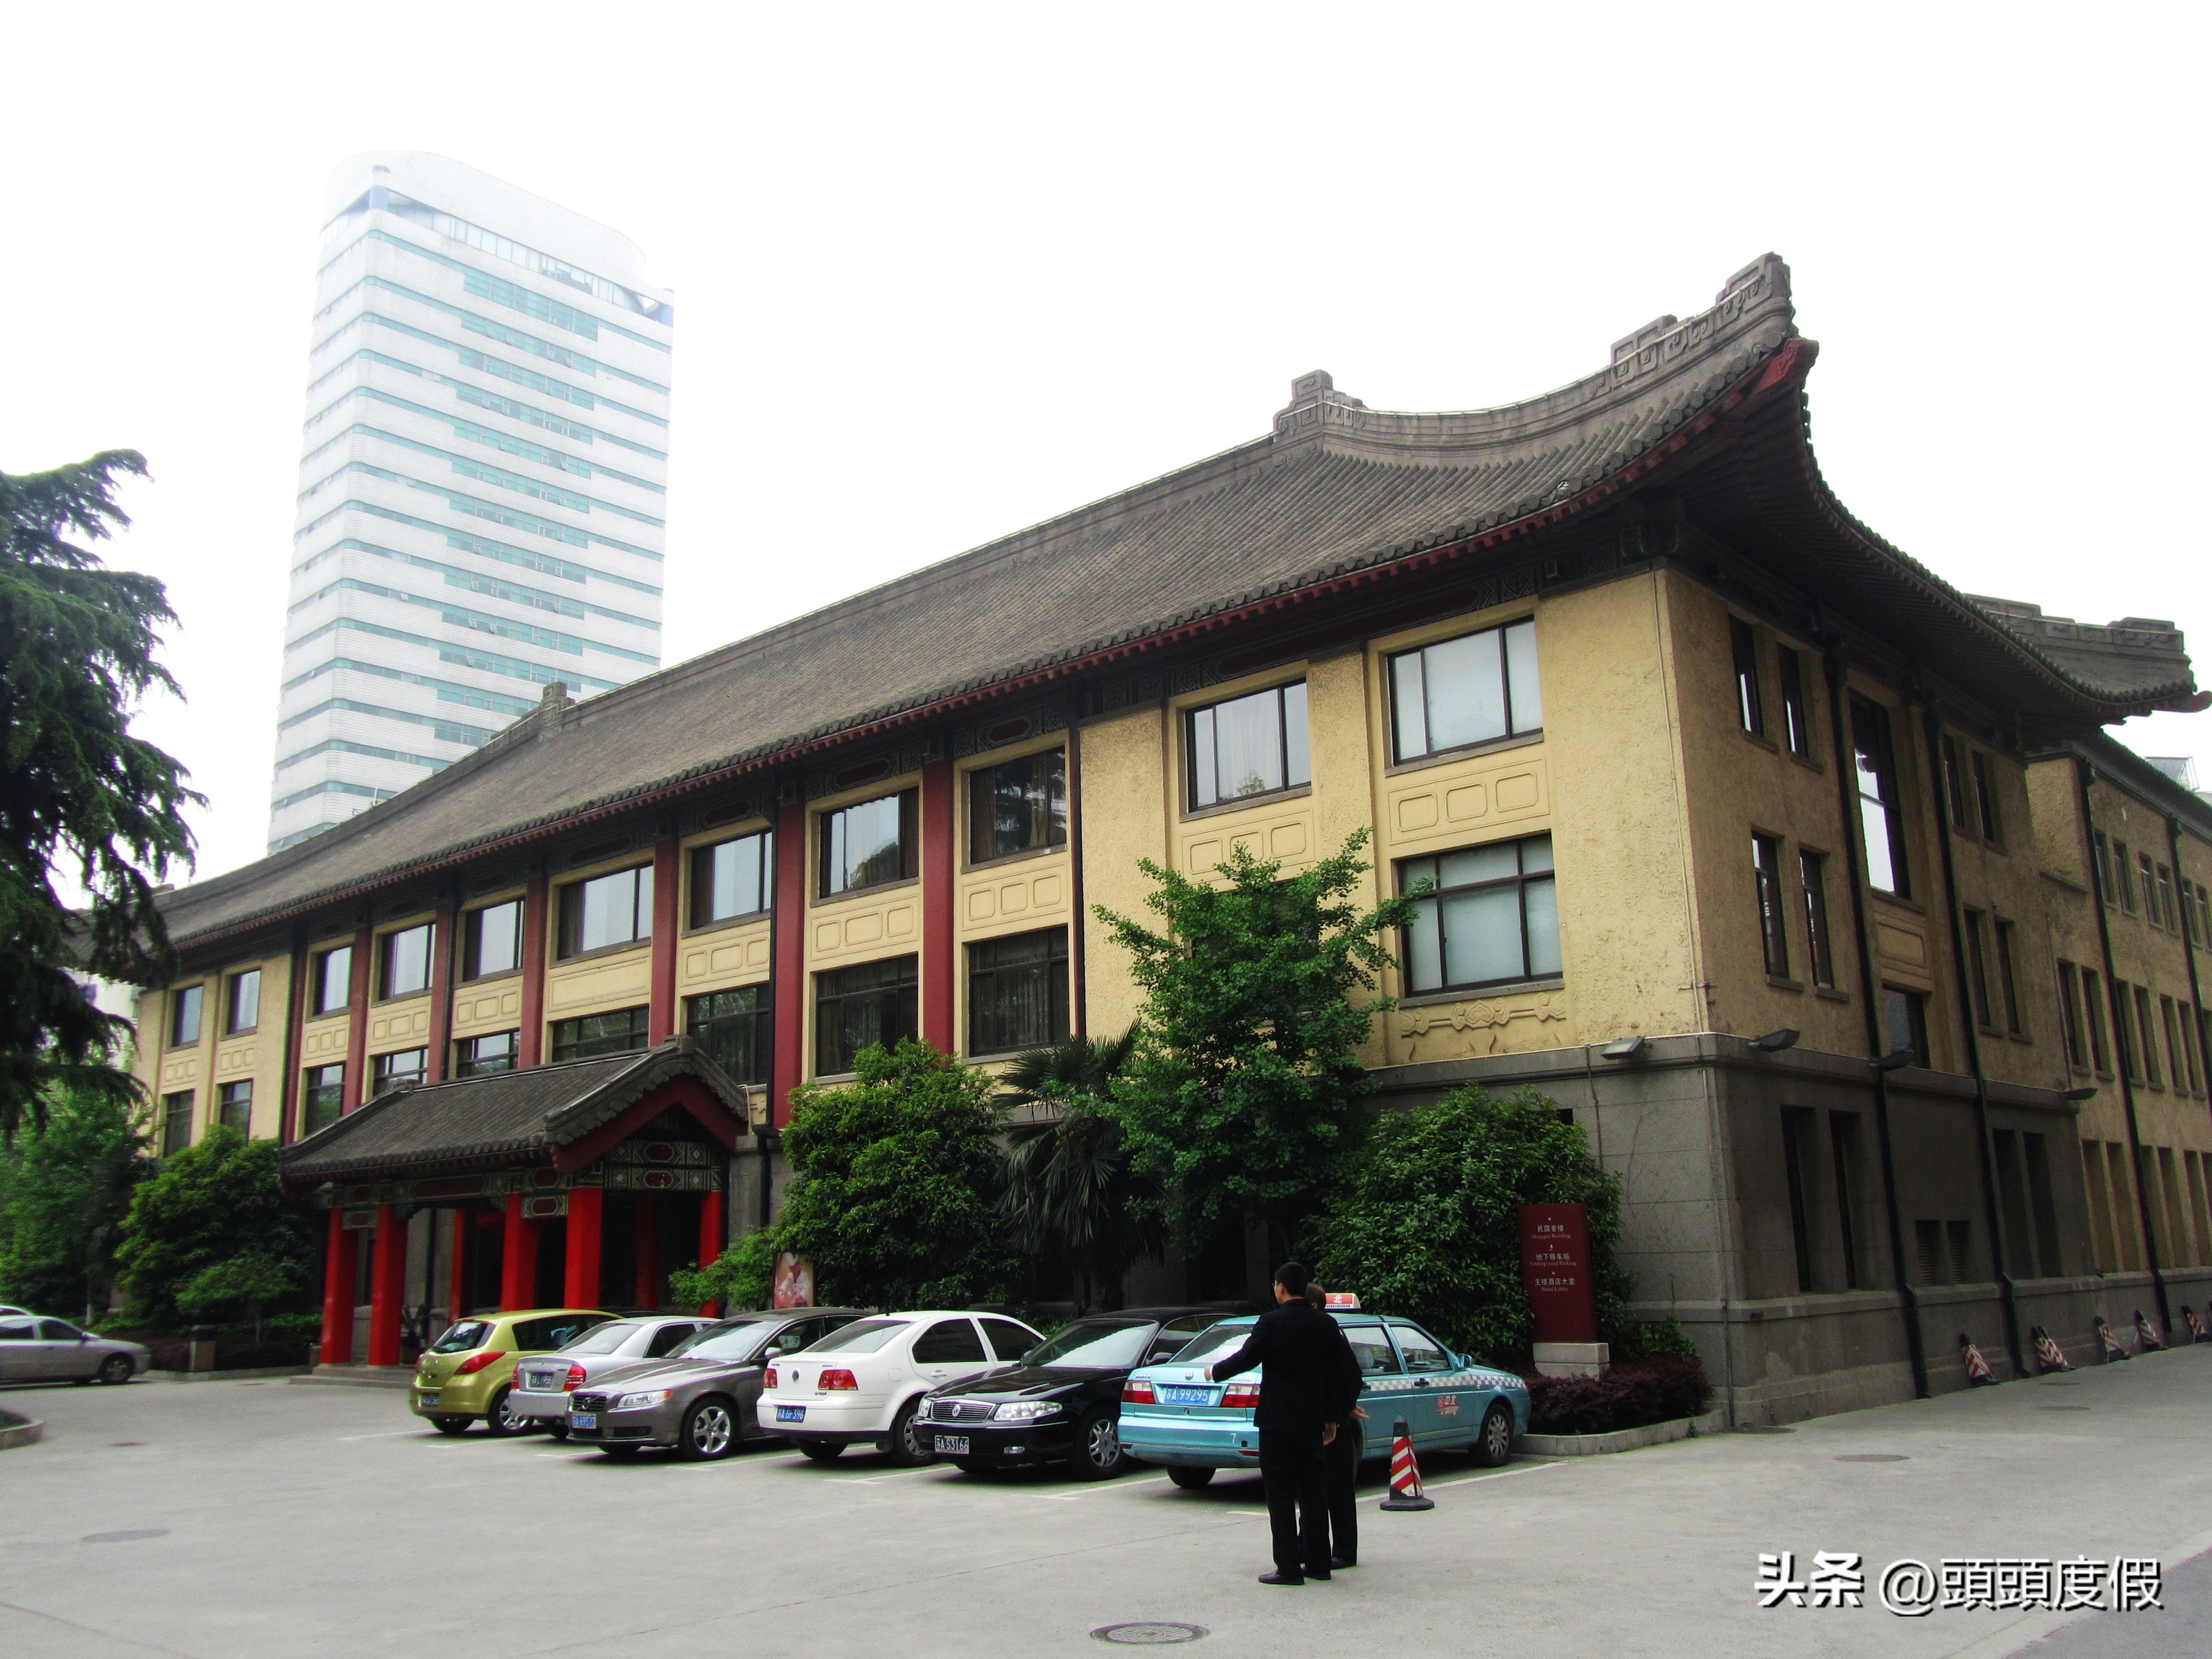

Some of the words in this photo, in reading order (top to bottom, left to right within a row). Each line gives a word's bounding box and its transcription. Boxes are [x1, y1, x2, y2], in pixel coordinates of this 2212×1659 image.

[1537, 1224, 1564, 1232] 民国老楼
[1535, 1277, 1575, 1286] 主楼酒店大堂
[1333, 1294, 1343, 1304] 北
